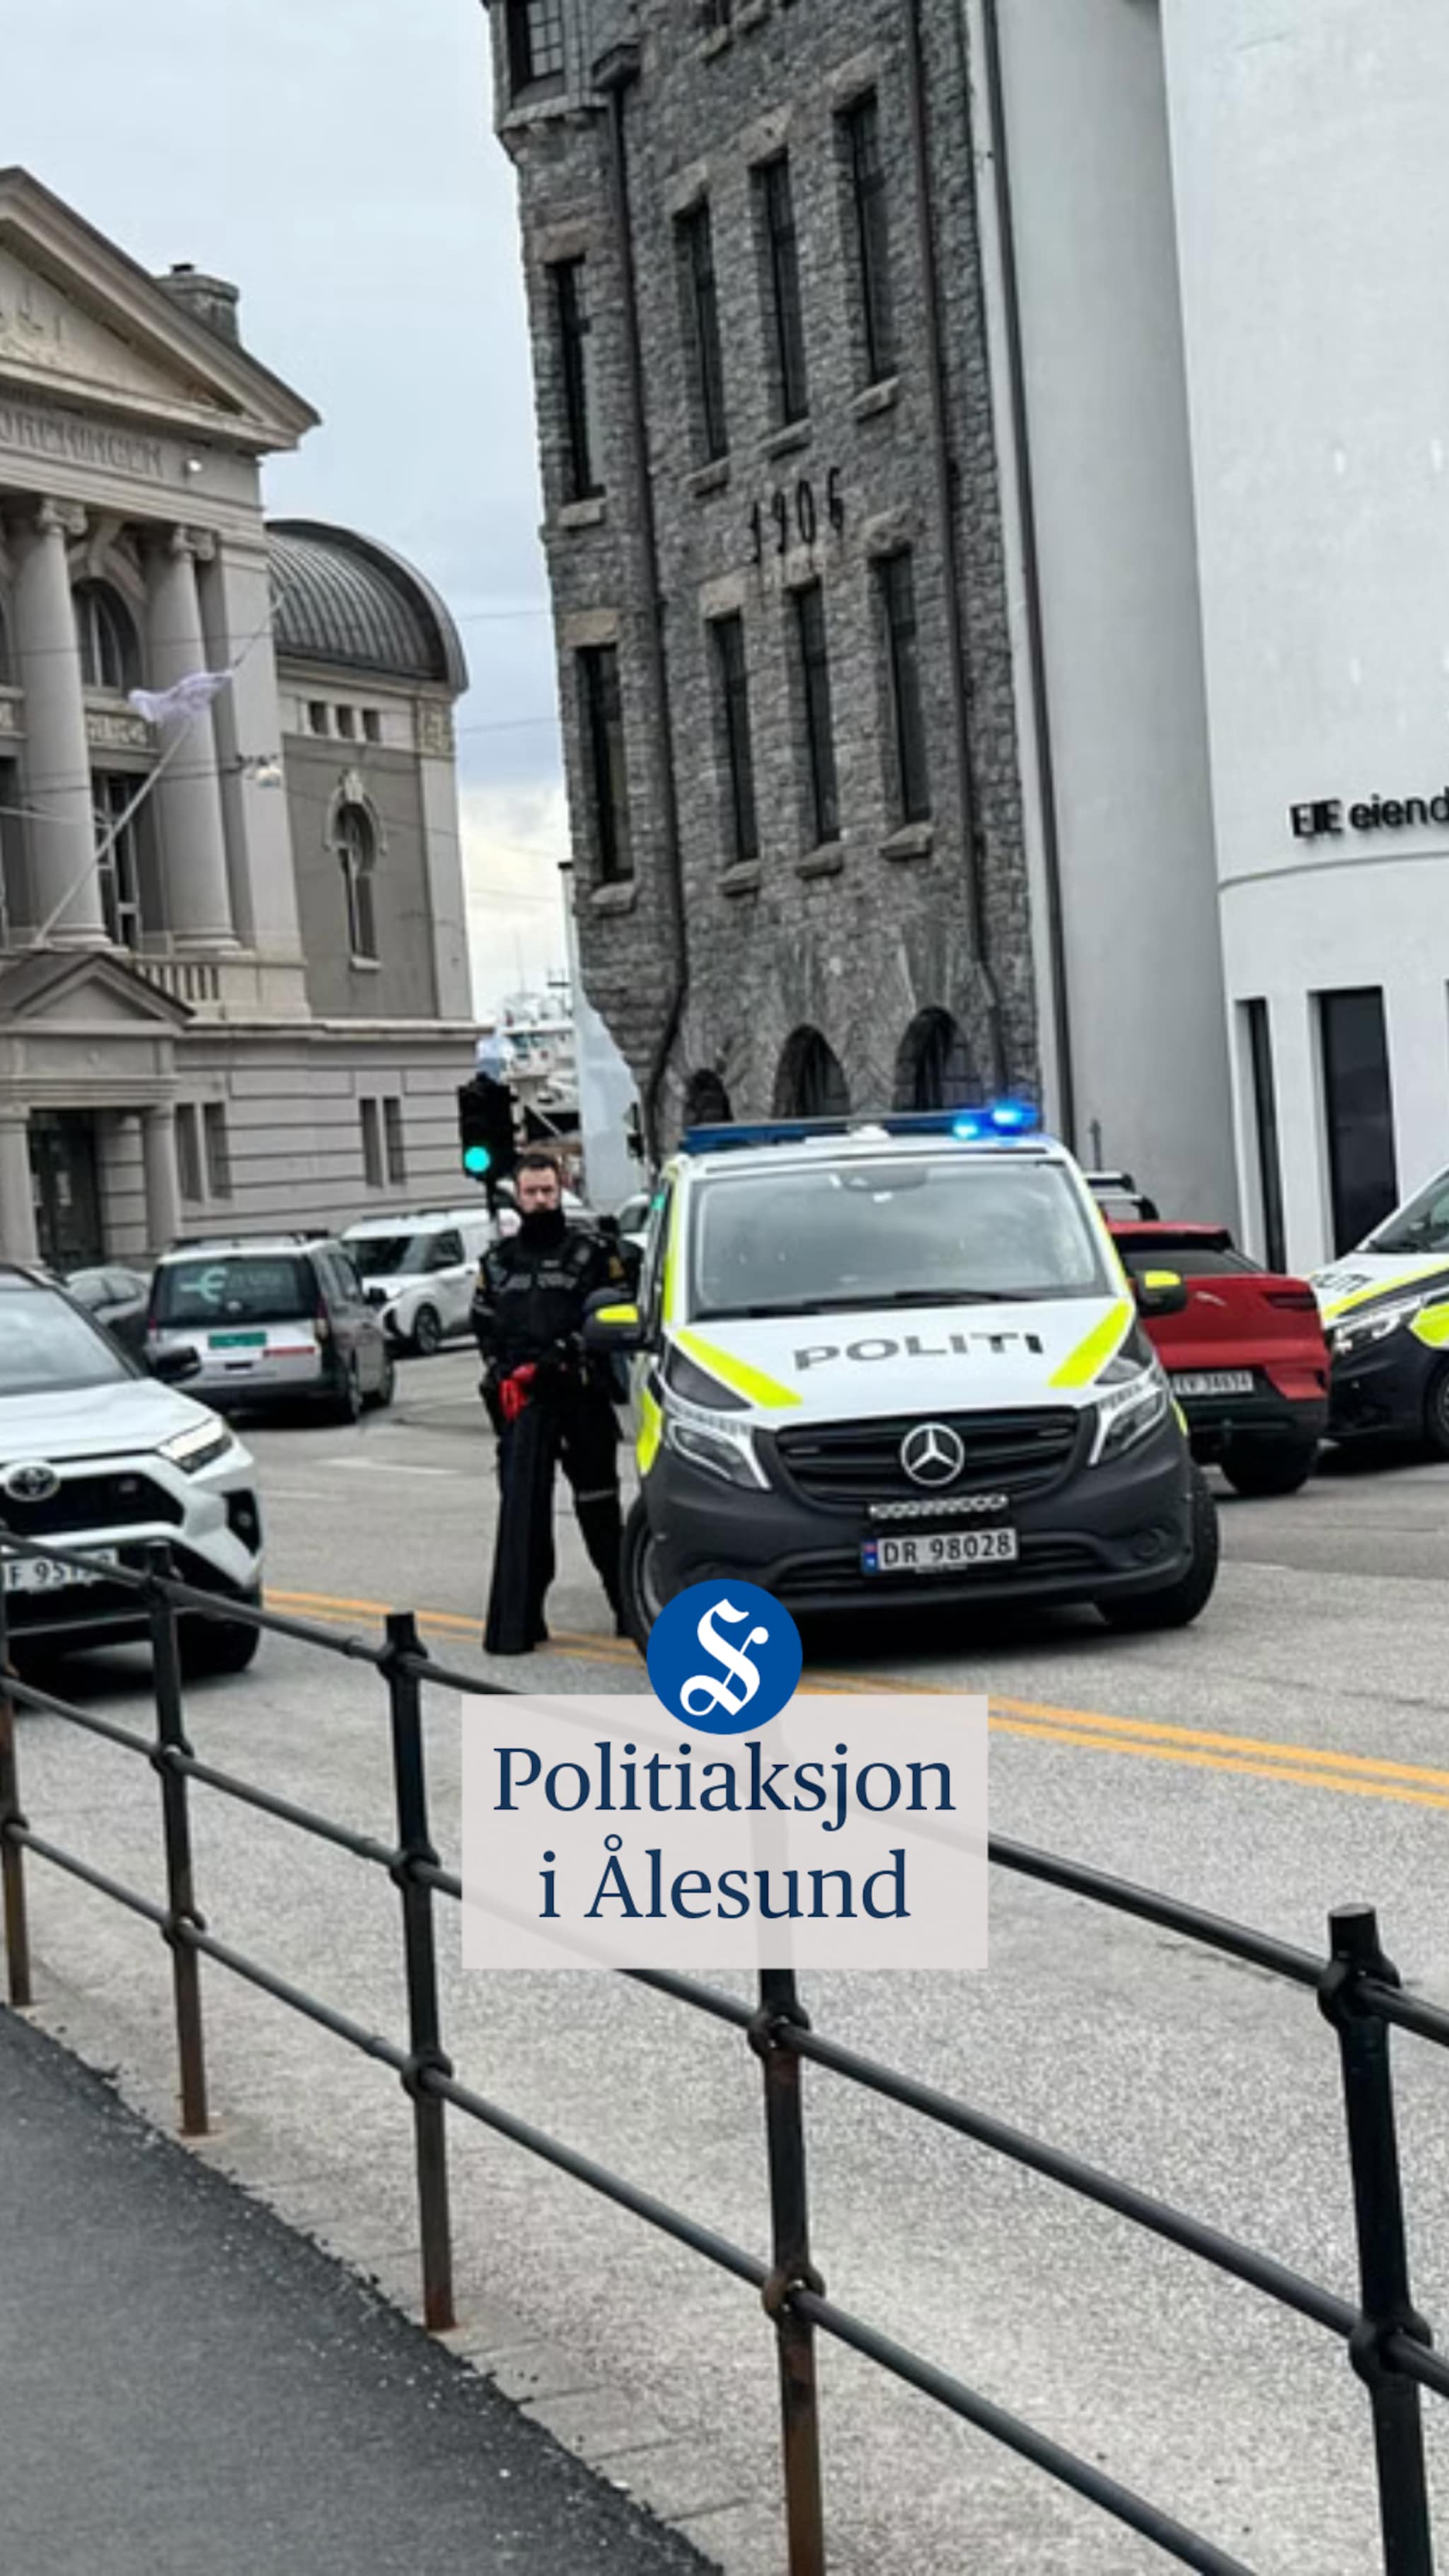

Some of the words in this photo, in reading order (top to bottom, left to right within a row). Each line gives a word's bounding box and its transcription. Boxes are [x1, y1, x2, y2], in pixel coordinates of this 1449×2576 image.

[749, 467, 844, 564] 1906
[793, 1332, 1044, 1371] POLITI
[884, 1540, 918, 1565] DR
[930, 1532, 1012, 1561] 98028
